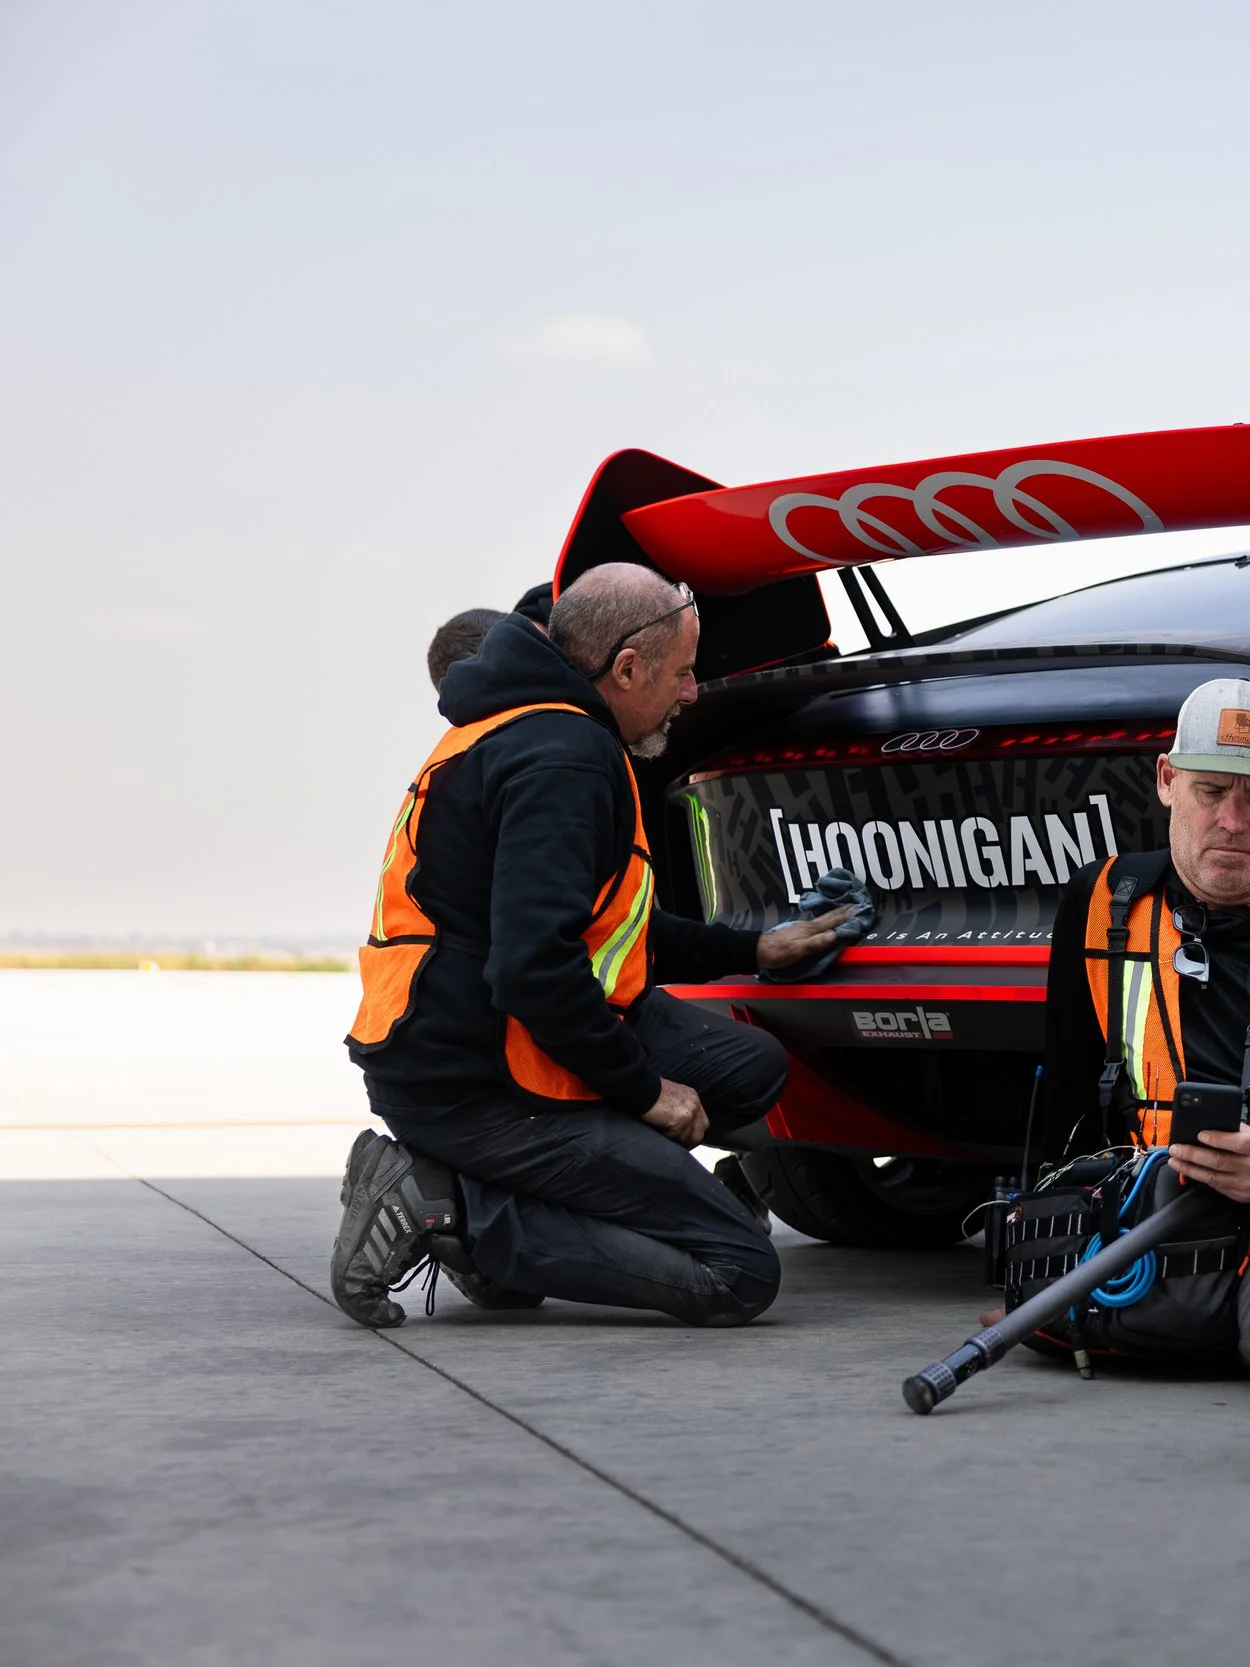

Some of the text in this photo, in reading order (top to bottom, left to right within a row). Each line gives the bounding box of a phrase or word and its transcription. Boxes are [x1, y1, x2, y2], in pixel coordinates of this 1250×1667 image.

[916, 931, 948, 940] An
[852, 1006, 952, 1040] Borla
[397, 1212, 412, 1234] TERREX
